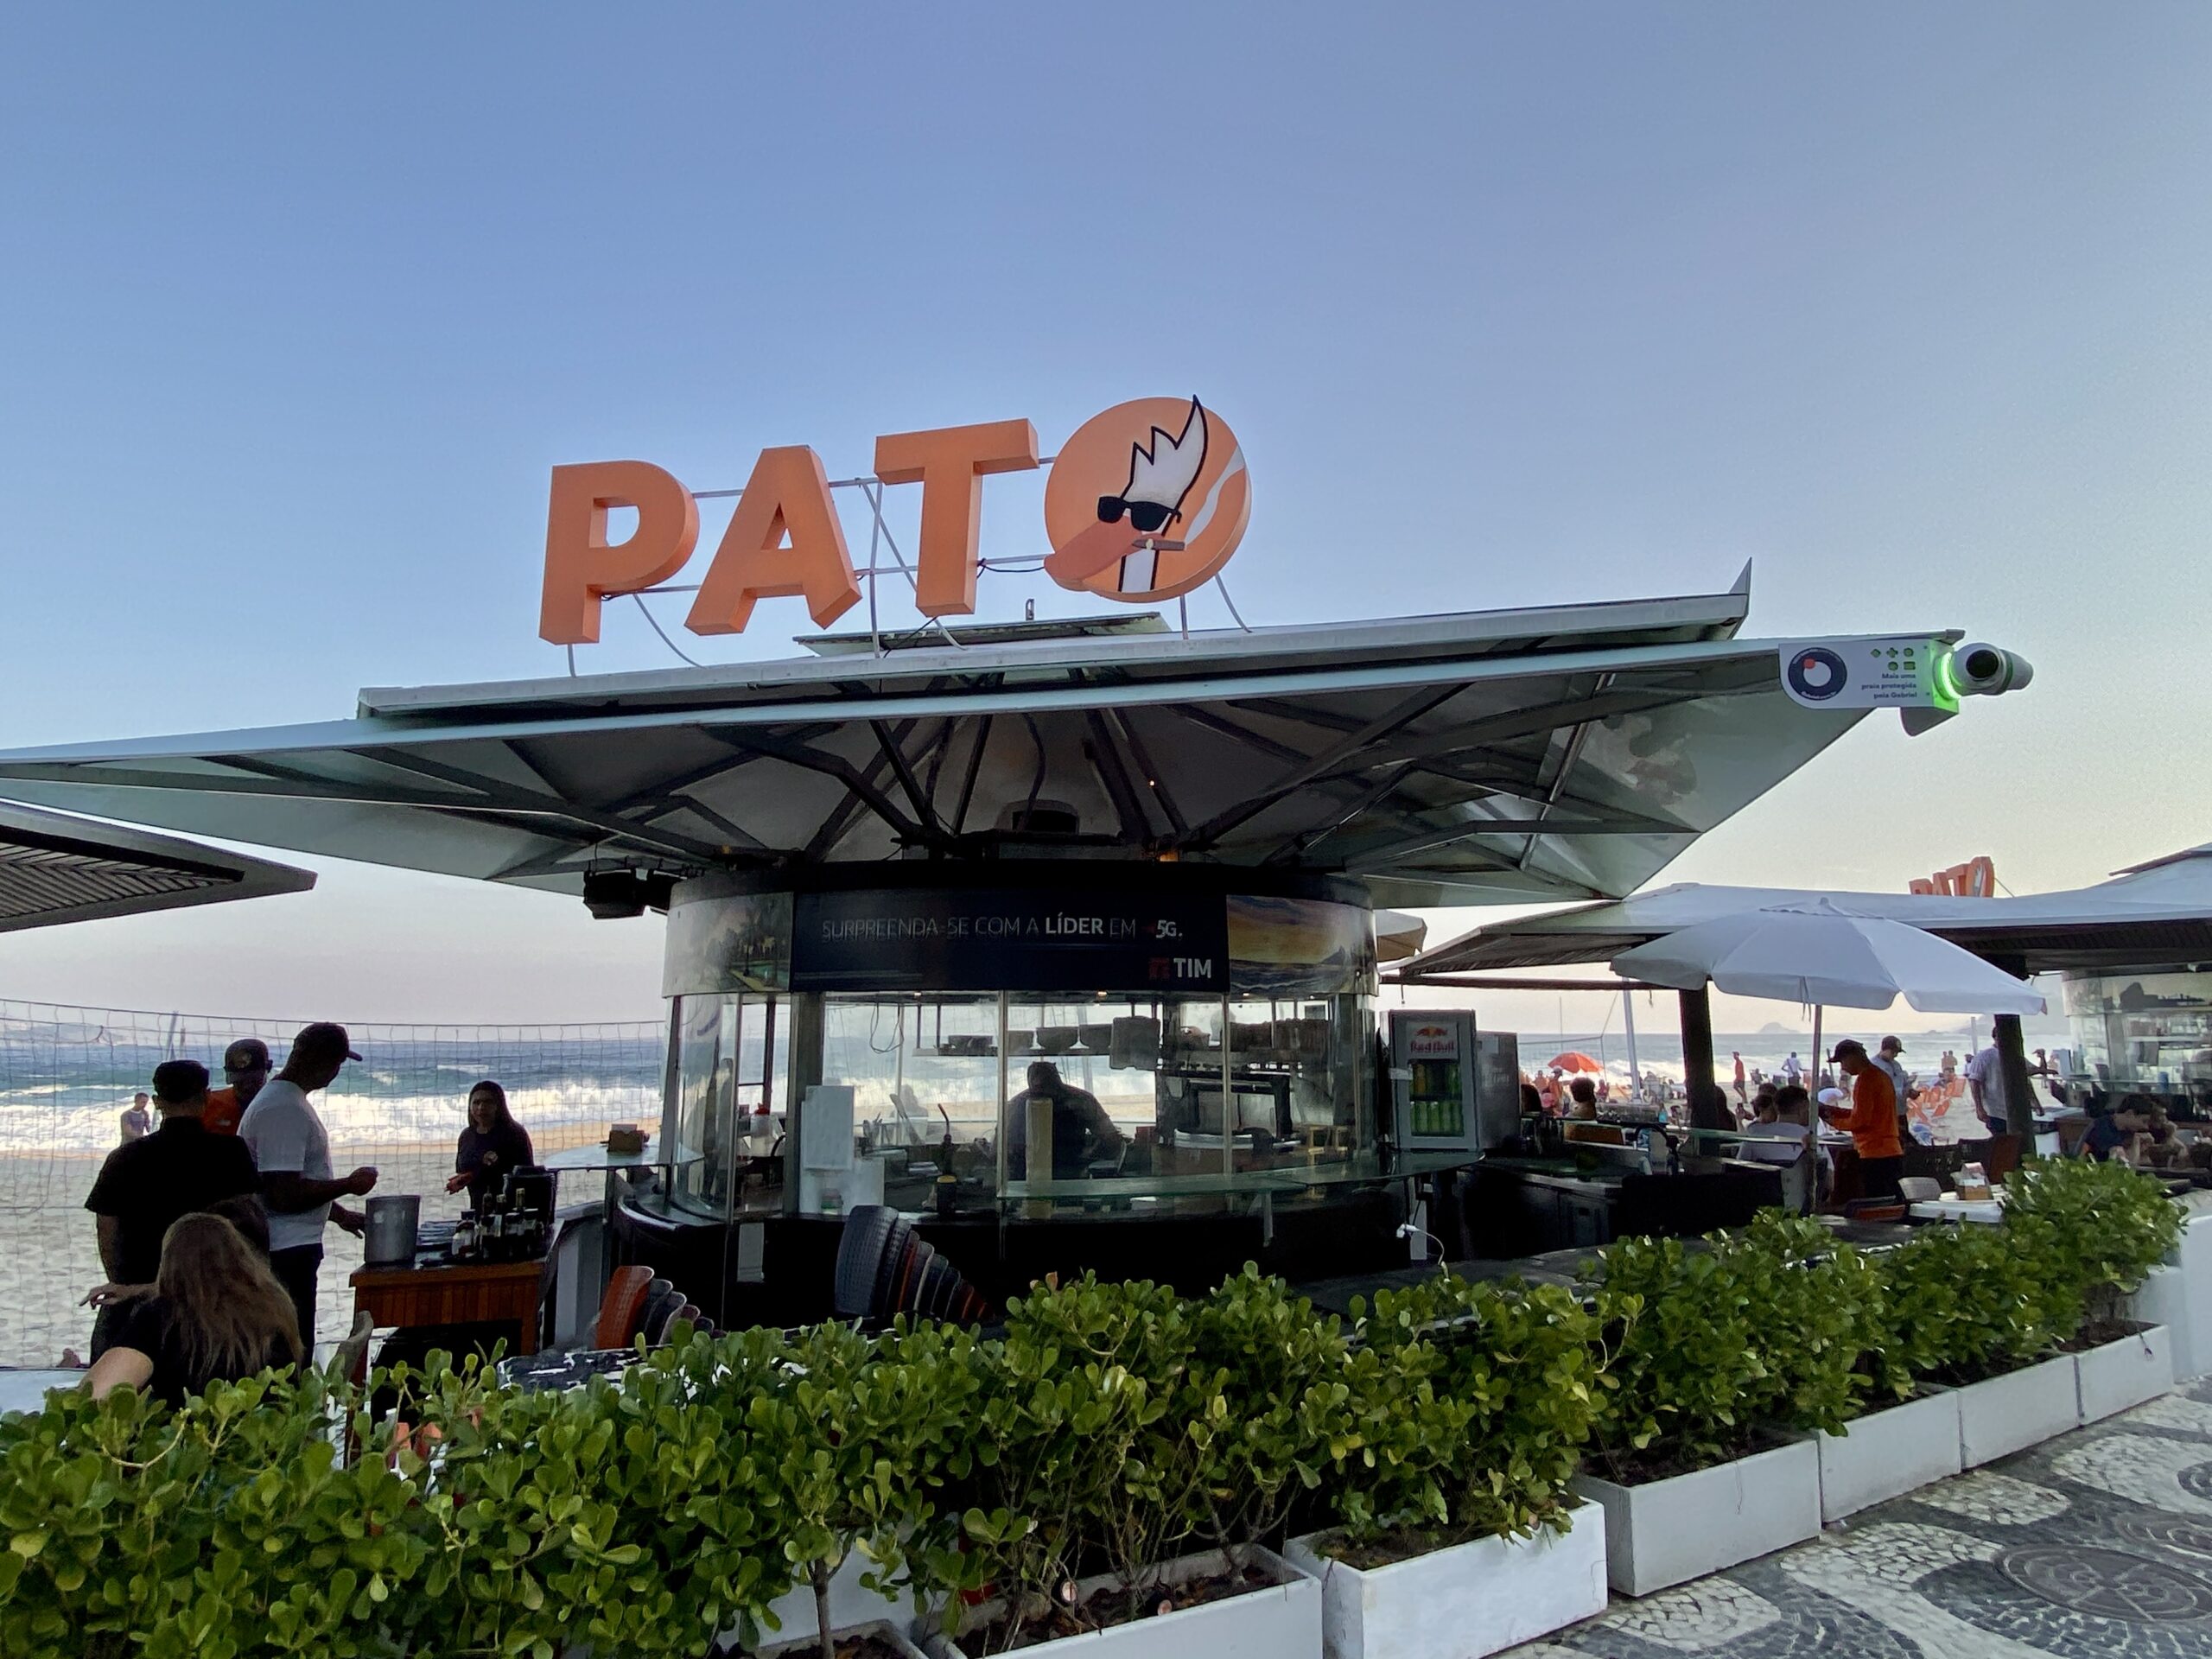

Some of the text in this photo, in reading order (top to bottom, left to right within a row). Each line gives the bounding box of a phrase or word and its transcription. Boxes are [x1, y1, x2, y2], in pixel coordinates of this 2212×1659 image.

[975, 916, 1020, 936] COM
[1026, 916, 1039, 935] A
[1046, 912, 1103, 935] LÍDER
[1109, 918, 1136, 939] EM
[1173, 957, 1211, 979] TIM
[1410, 1040, 1454, 1053] Red Bull
